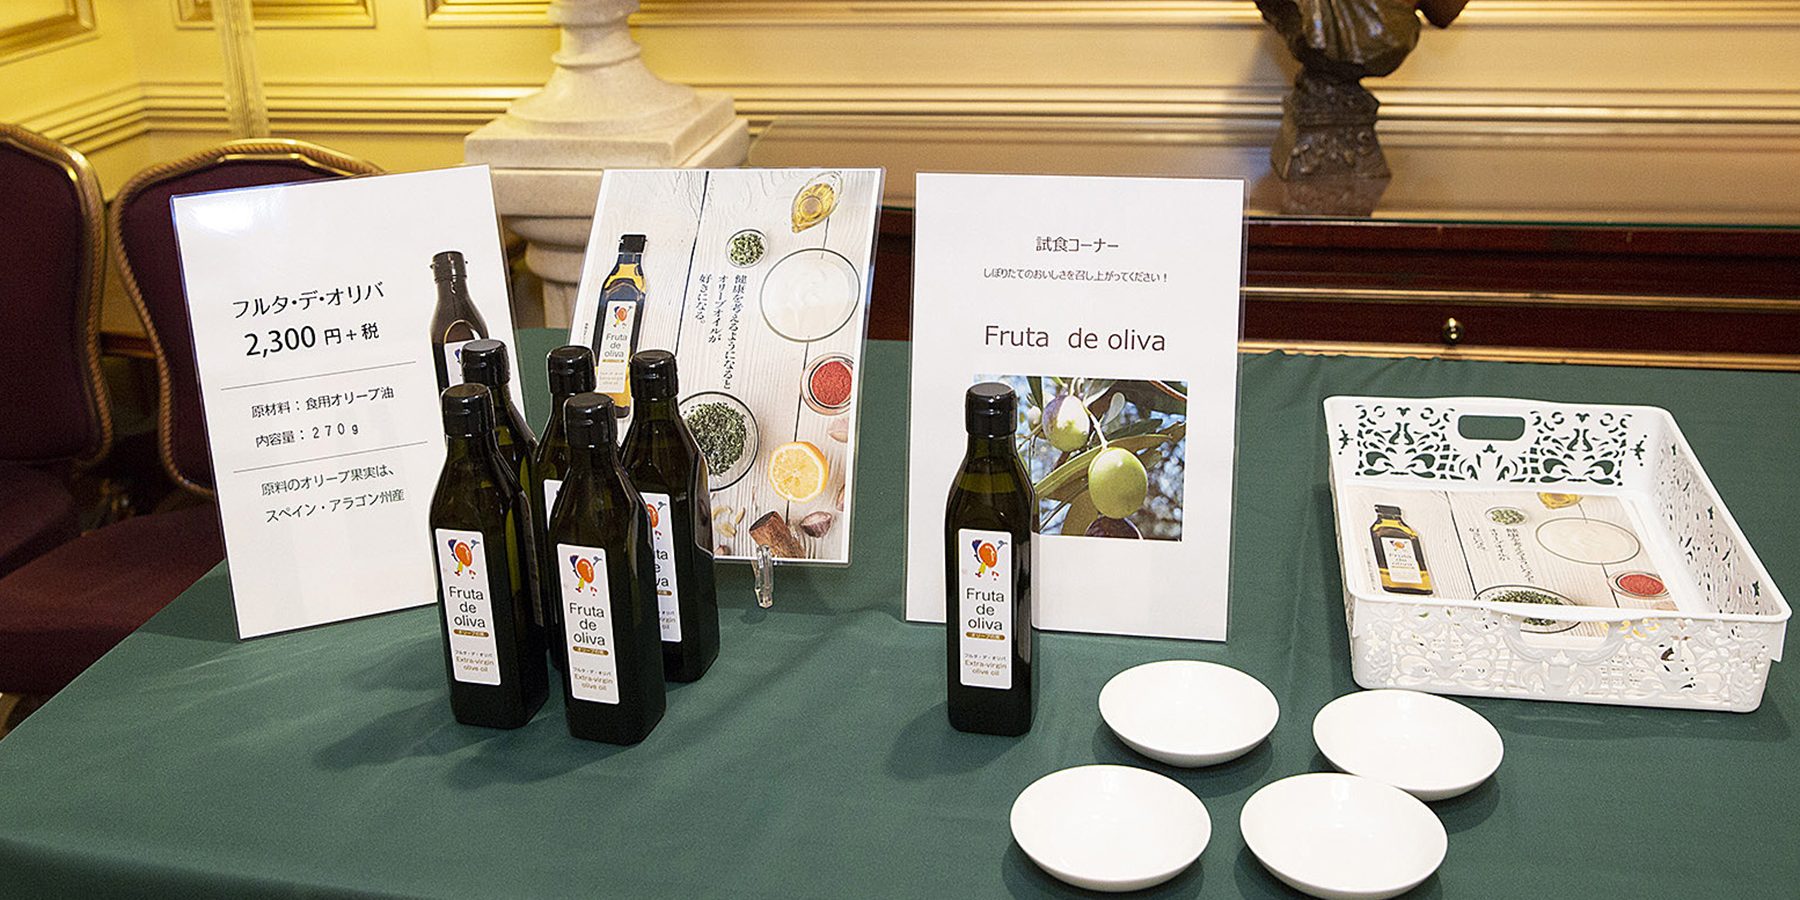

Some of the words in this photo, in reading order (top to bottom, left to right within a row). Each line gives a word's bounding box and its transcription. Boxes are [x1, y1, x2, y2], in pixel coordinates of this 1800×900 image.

[1036, 236, 1119, 252] 試食コーナー
[983, 268, 1168, 283] しぼりたてのおいしさを召し上がってください！
[232, 281, 385, 319] フルタ・デ・オリバ
[708, 275, 728, 343] オリーブオイルが
[244, 325, 316, 358] 2,300
[606, 333, 628, 341] Fruta
[985, 325, 1049, 348] Fruta
[1068, 327, 1098, 349] de
[1108, 329, 1166, 351] oliva
[604, 350, 624, 358] oliva
[266, 489, 405, 523] スペイン・アラゴン州産
[449, 586, 484, 600] Fruta
[967, 588, 1004, 602] Fruta
[460, 601, 477, 614] de
[569, 602, 605, 618] Fruta
[976, 603, 995, 616] de
[454, 615, 486, 628] oliva
[579, 618, 597, 631] de
[968, 617, 1002, 631] oliva
[574, 632, 606, 646] oliva
